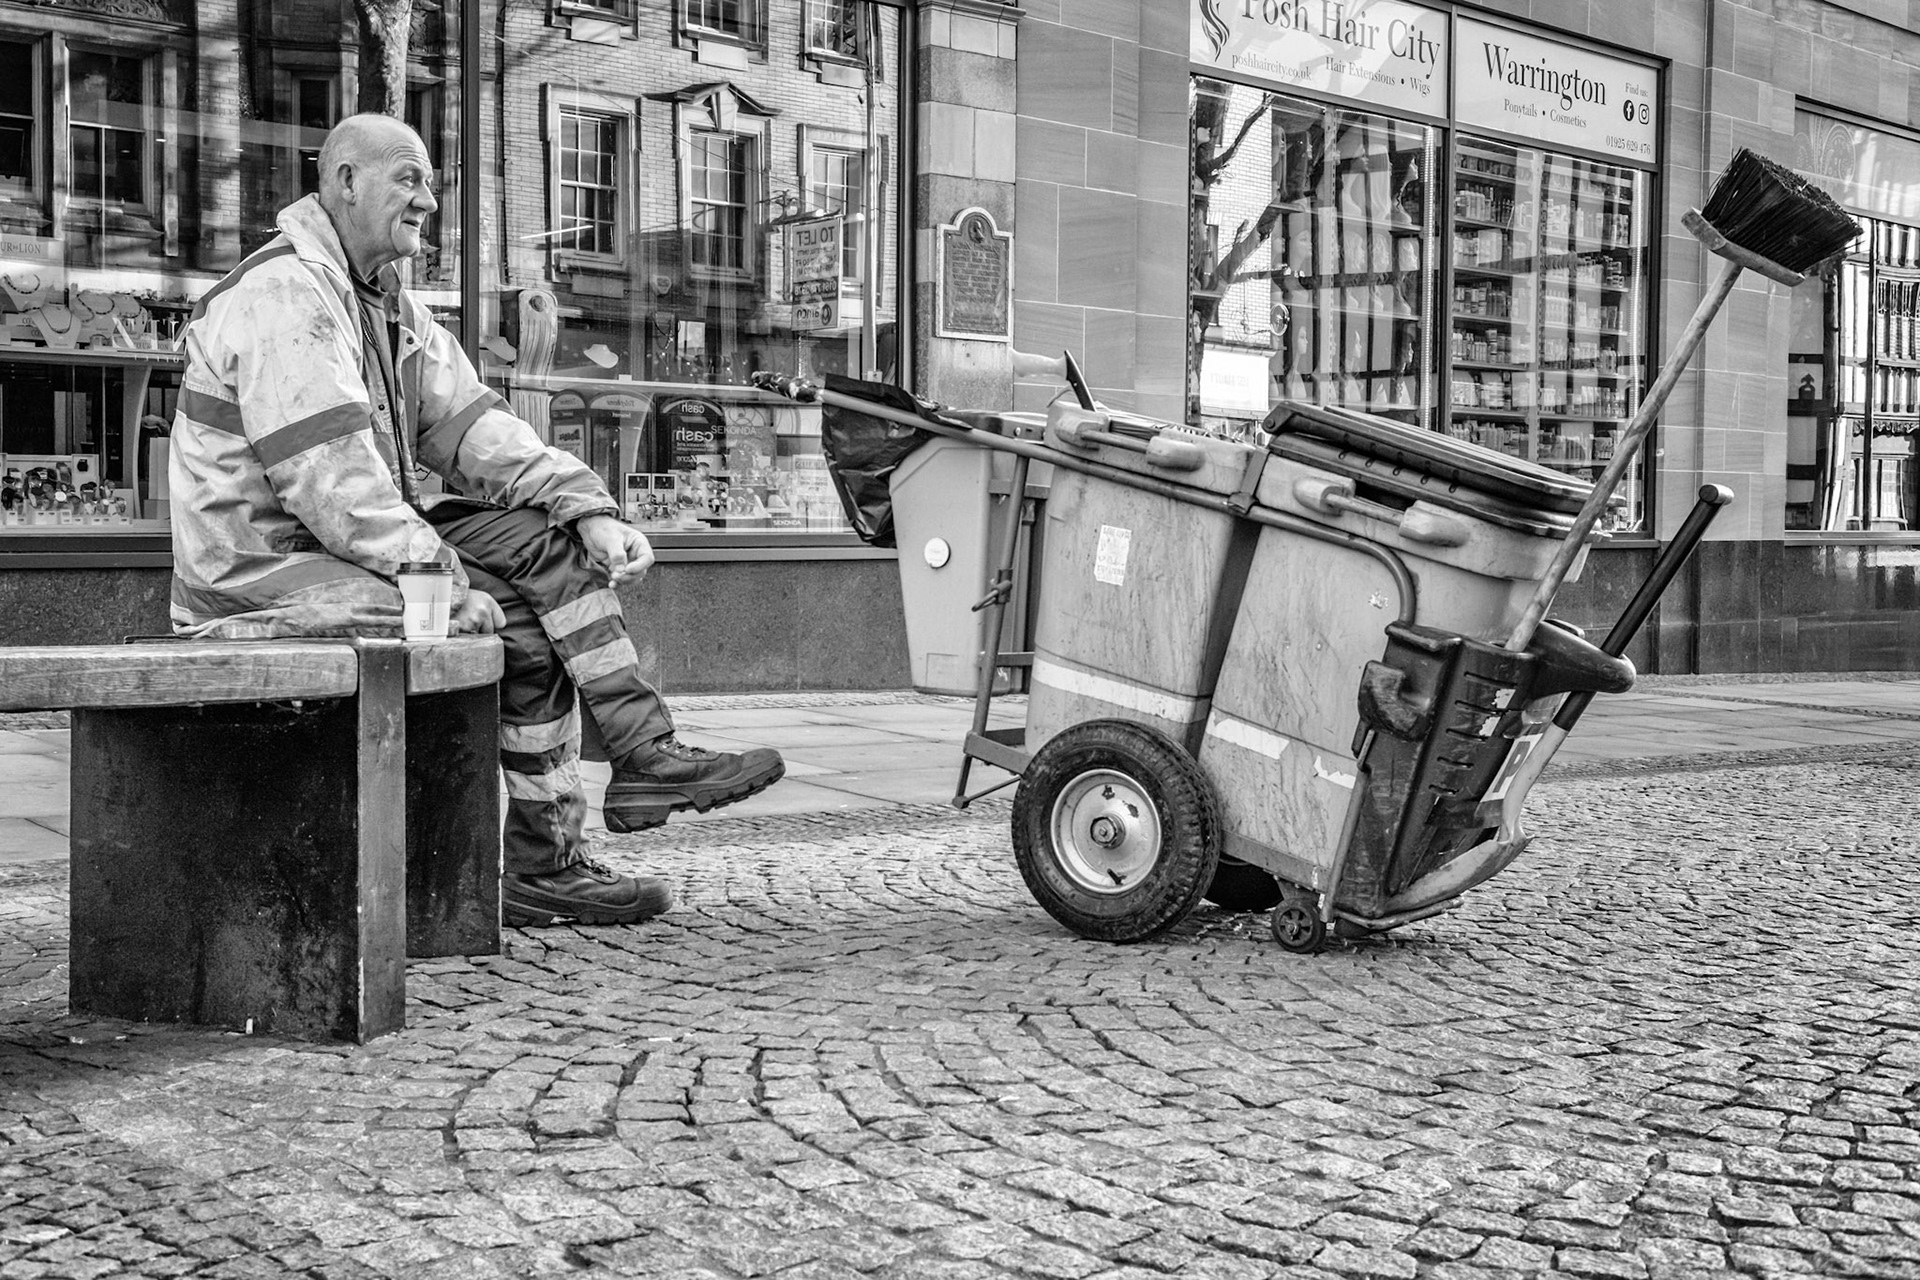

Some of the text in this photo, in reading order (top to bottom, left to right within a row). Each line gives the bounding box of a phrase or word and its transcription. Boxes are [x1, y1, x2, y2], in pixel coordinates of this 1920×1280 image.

[1319, 0, 1380, 51] Hair
[1388, 19, 1441, 80] City
[1232, 54, 1312, 82] poshhaircity.co.uk
[1326, 57, 1431, 96] Hair Extensions Wigs
[1483, 42, 1607, 111] Warrington
[1625, 82, 1639, 96] Find
[1504, 98, 1587, 128] Ponytails Cosmetics
[1606, 135, 1626, 150] 01925
[19, 243, 41, 254] LION
[710, 425, 757, 435] SEKONDA
